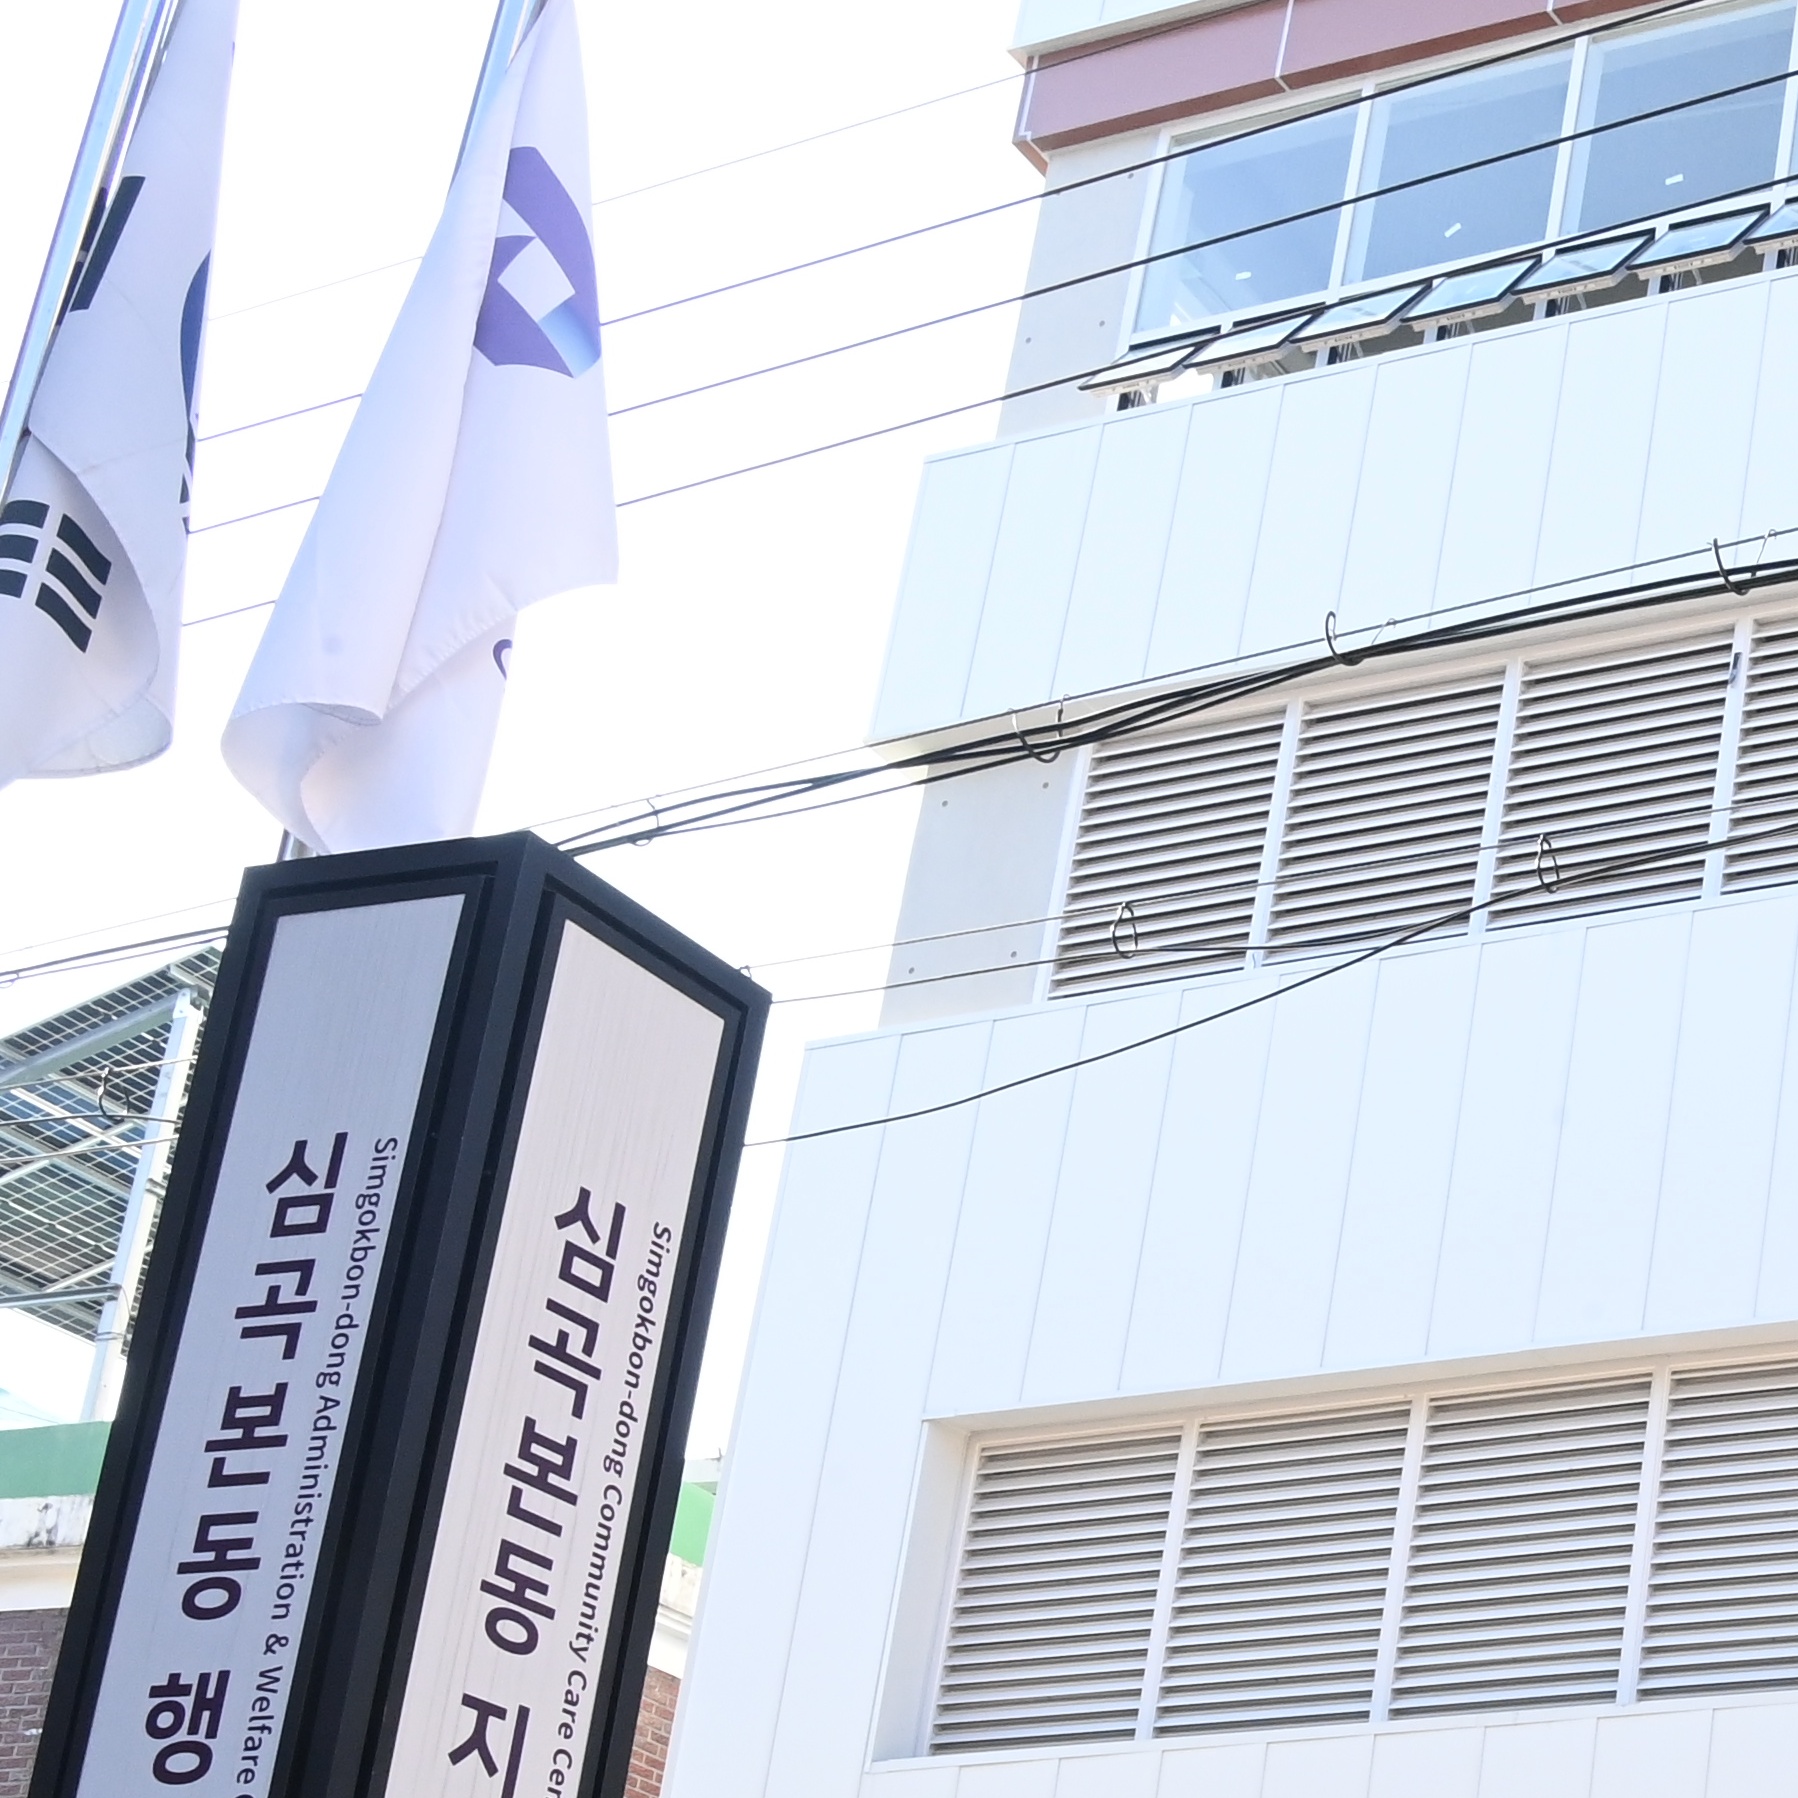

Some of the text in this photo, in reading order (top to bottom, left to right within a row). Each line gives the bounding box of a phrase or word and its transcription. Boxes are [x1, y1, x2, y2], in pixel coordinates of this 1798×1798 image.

[315, 1136, 398, 1388] Simgokbon-dong
[602, 1221, 672, 1477] Simgokbon-dong
[176, 1131, 348, 1620] 심곡본동
[480, 1187, 627, 1656] 심곡본동
[270, 1397, 340, 1620] Administration
[565, 1484, 624, 1665] Community
[234, 1665, 284, 1786] Welfare
[265, 1633, 290, 1656] &
[555, 1668, 588, 1742] Care
